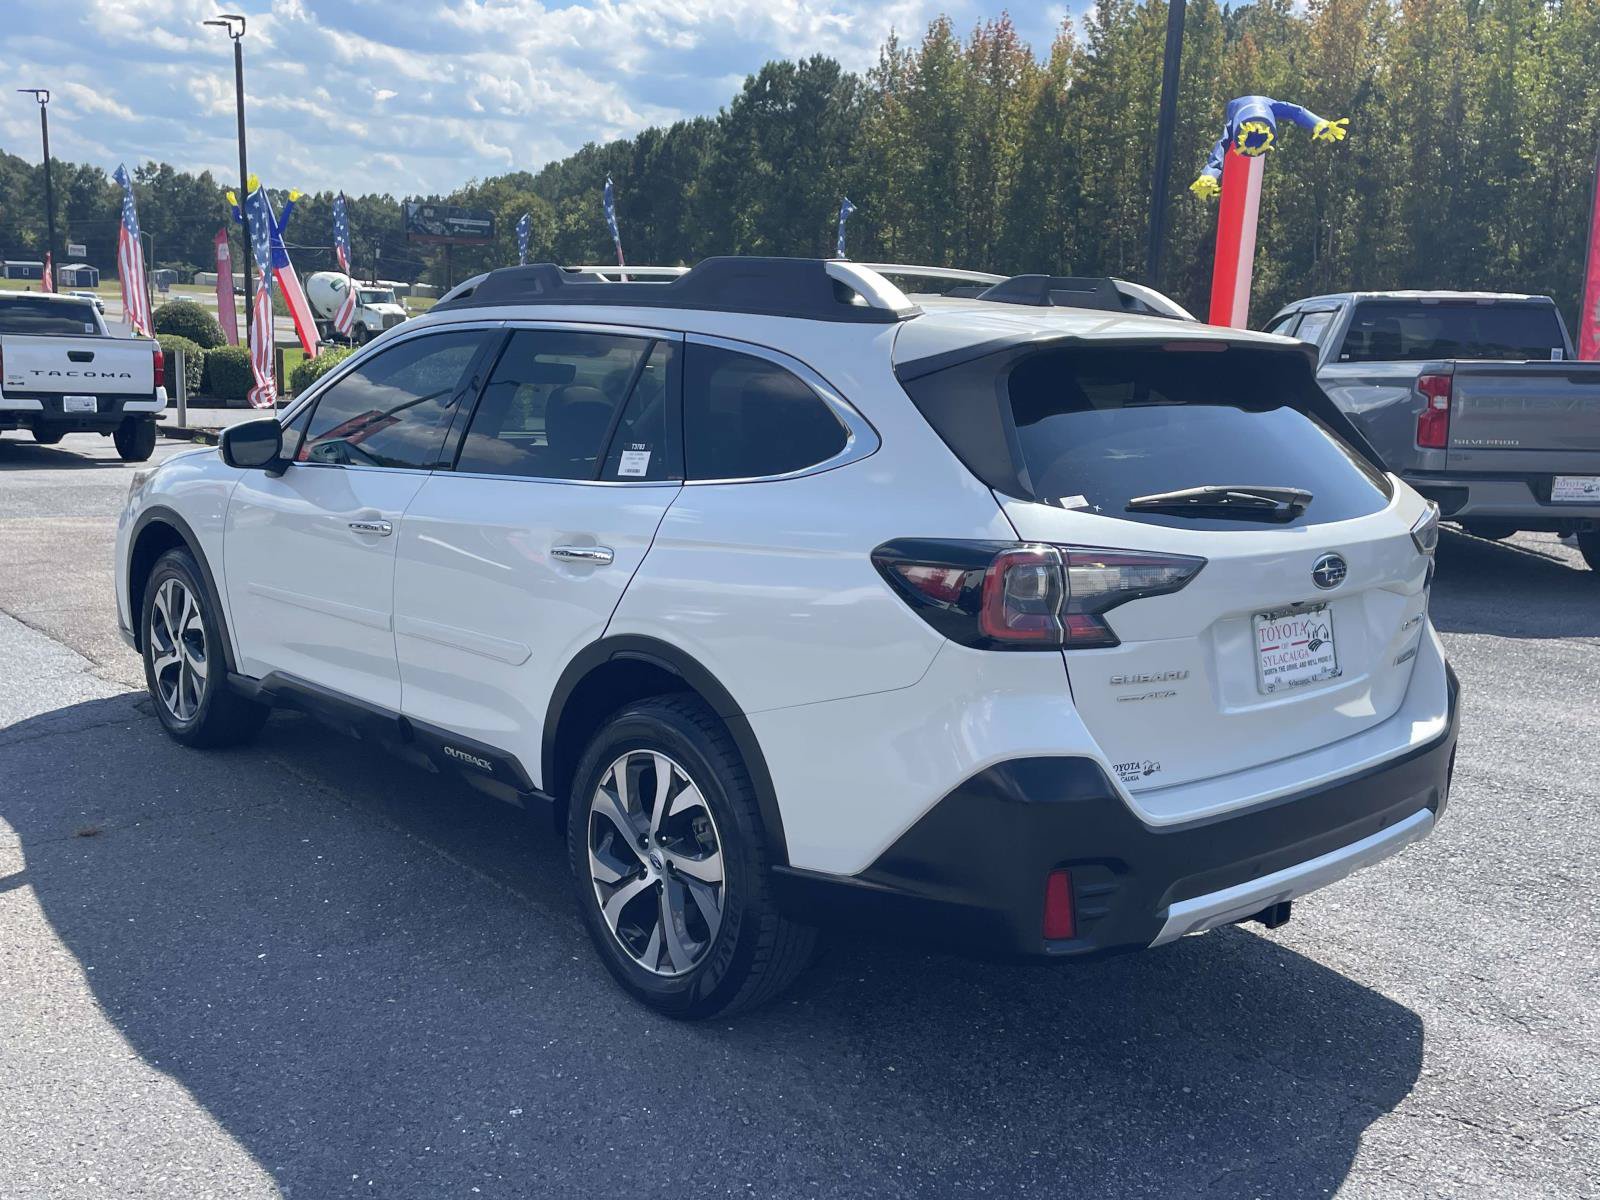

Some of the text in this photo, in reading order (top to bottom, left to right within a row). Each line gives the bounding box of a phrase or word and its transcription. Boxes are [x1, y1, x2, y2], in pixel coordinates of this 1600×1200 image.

[30, 369, 132, 379] TACOMA
[1454, 438, 1520, 446] SILVERADO
[1259, 622, 1307, 642] TOYOTA
[1262, 649, 1310, 668] SYLACAUGA
[1264, 667, 1278, 676] WORTH
[1110, 671, 1189, 685] SUBARU
[443, 746, 493, 771] OUTBACK
[1112, 762, 1141, 772] OYOTA
